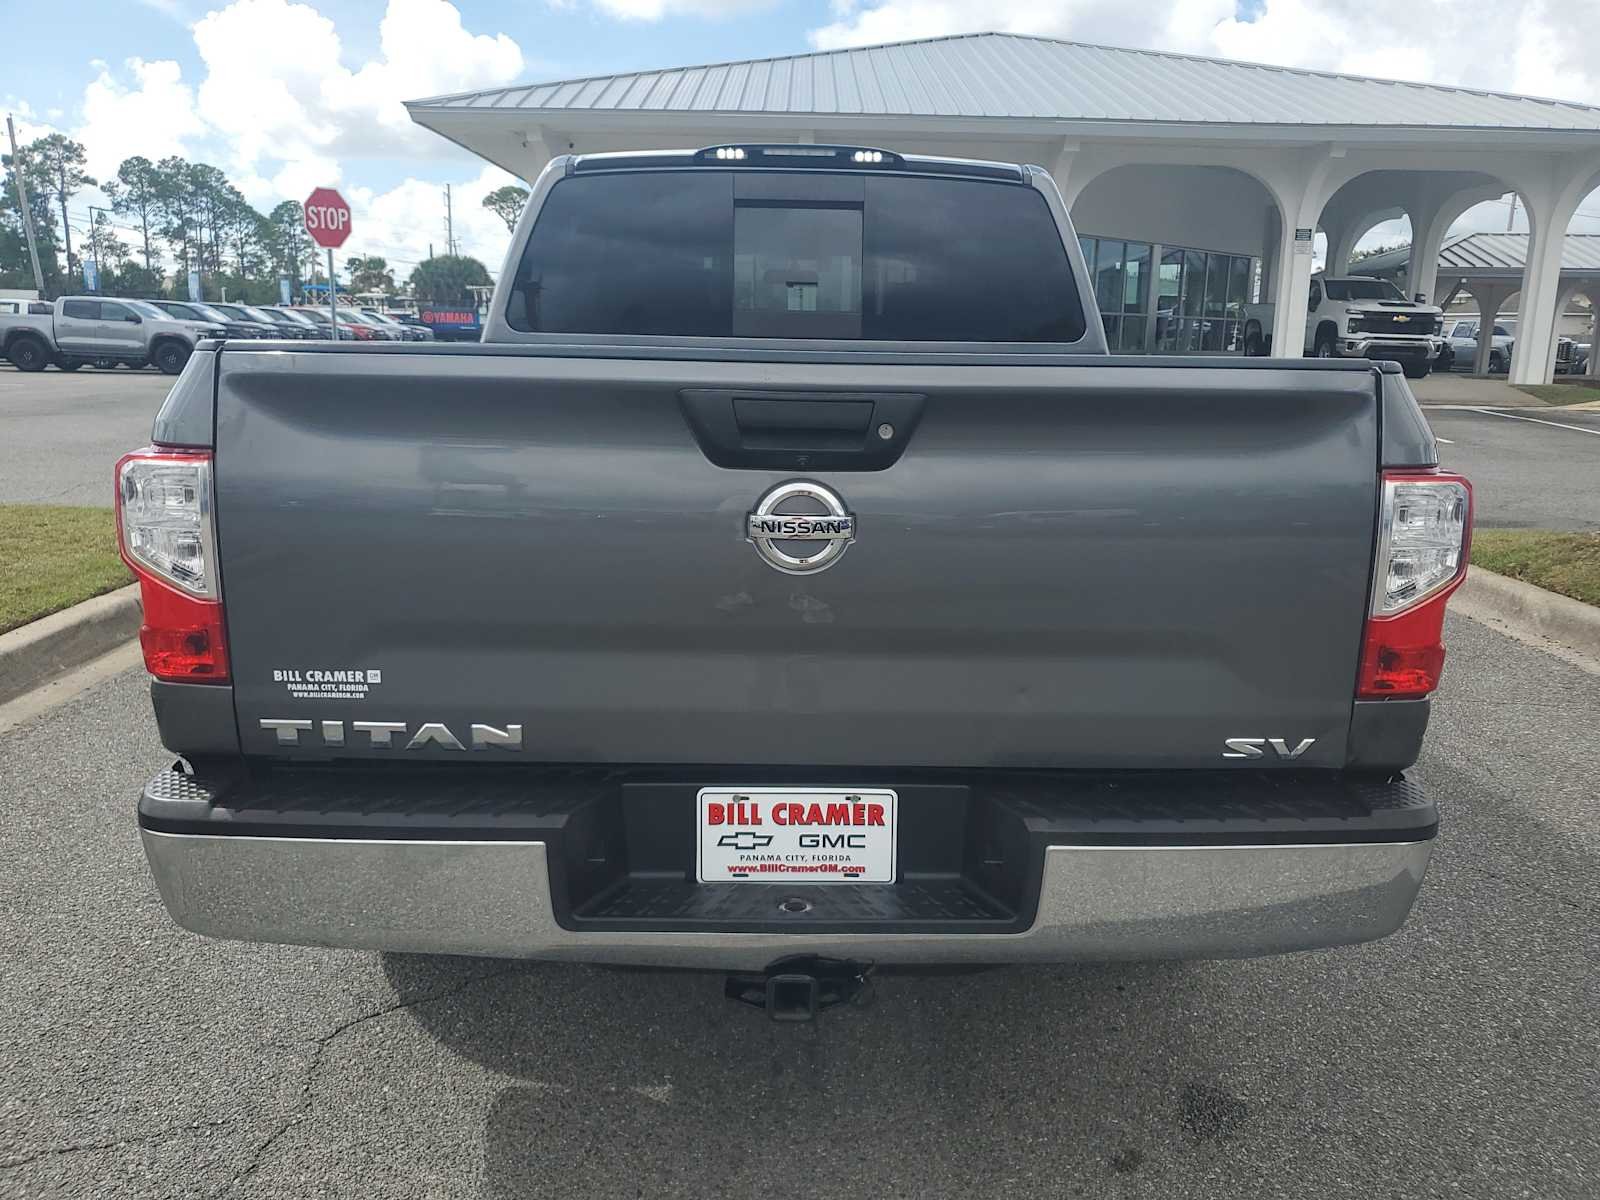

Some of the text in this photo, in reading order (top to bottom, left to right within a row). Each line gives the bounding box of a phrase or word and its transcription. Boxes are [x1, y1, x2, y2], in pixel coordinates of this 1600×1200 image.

[308, 205, 349, 230] STOP
[434, 311, 474, 324] YAMAHA
[761, 521, 841, 534] NISSAN
[273, 670, 302, 682] BILL
[305, 670, 365, 683] CRAMER
[287, 683, 369, 692] PANAMA CITY, FLORIDA
[259, 719, 523, 750] TITAN
[1222, 738, 1316, 760] SV
[707, 802, 886, 827] BILL CRAMER
[798, 833, 867, 849] GMC
[739, 854, 852, 863] PANAMA CITY, FLORIDA
[727, 863, 867, 874] www.BillCramerGM.com
